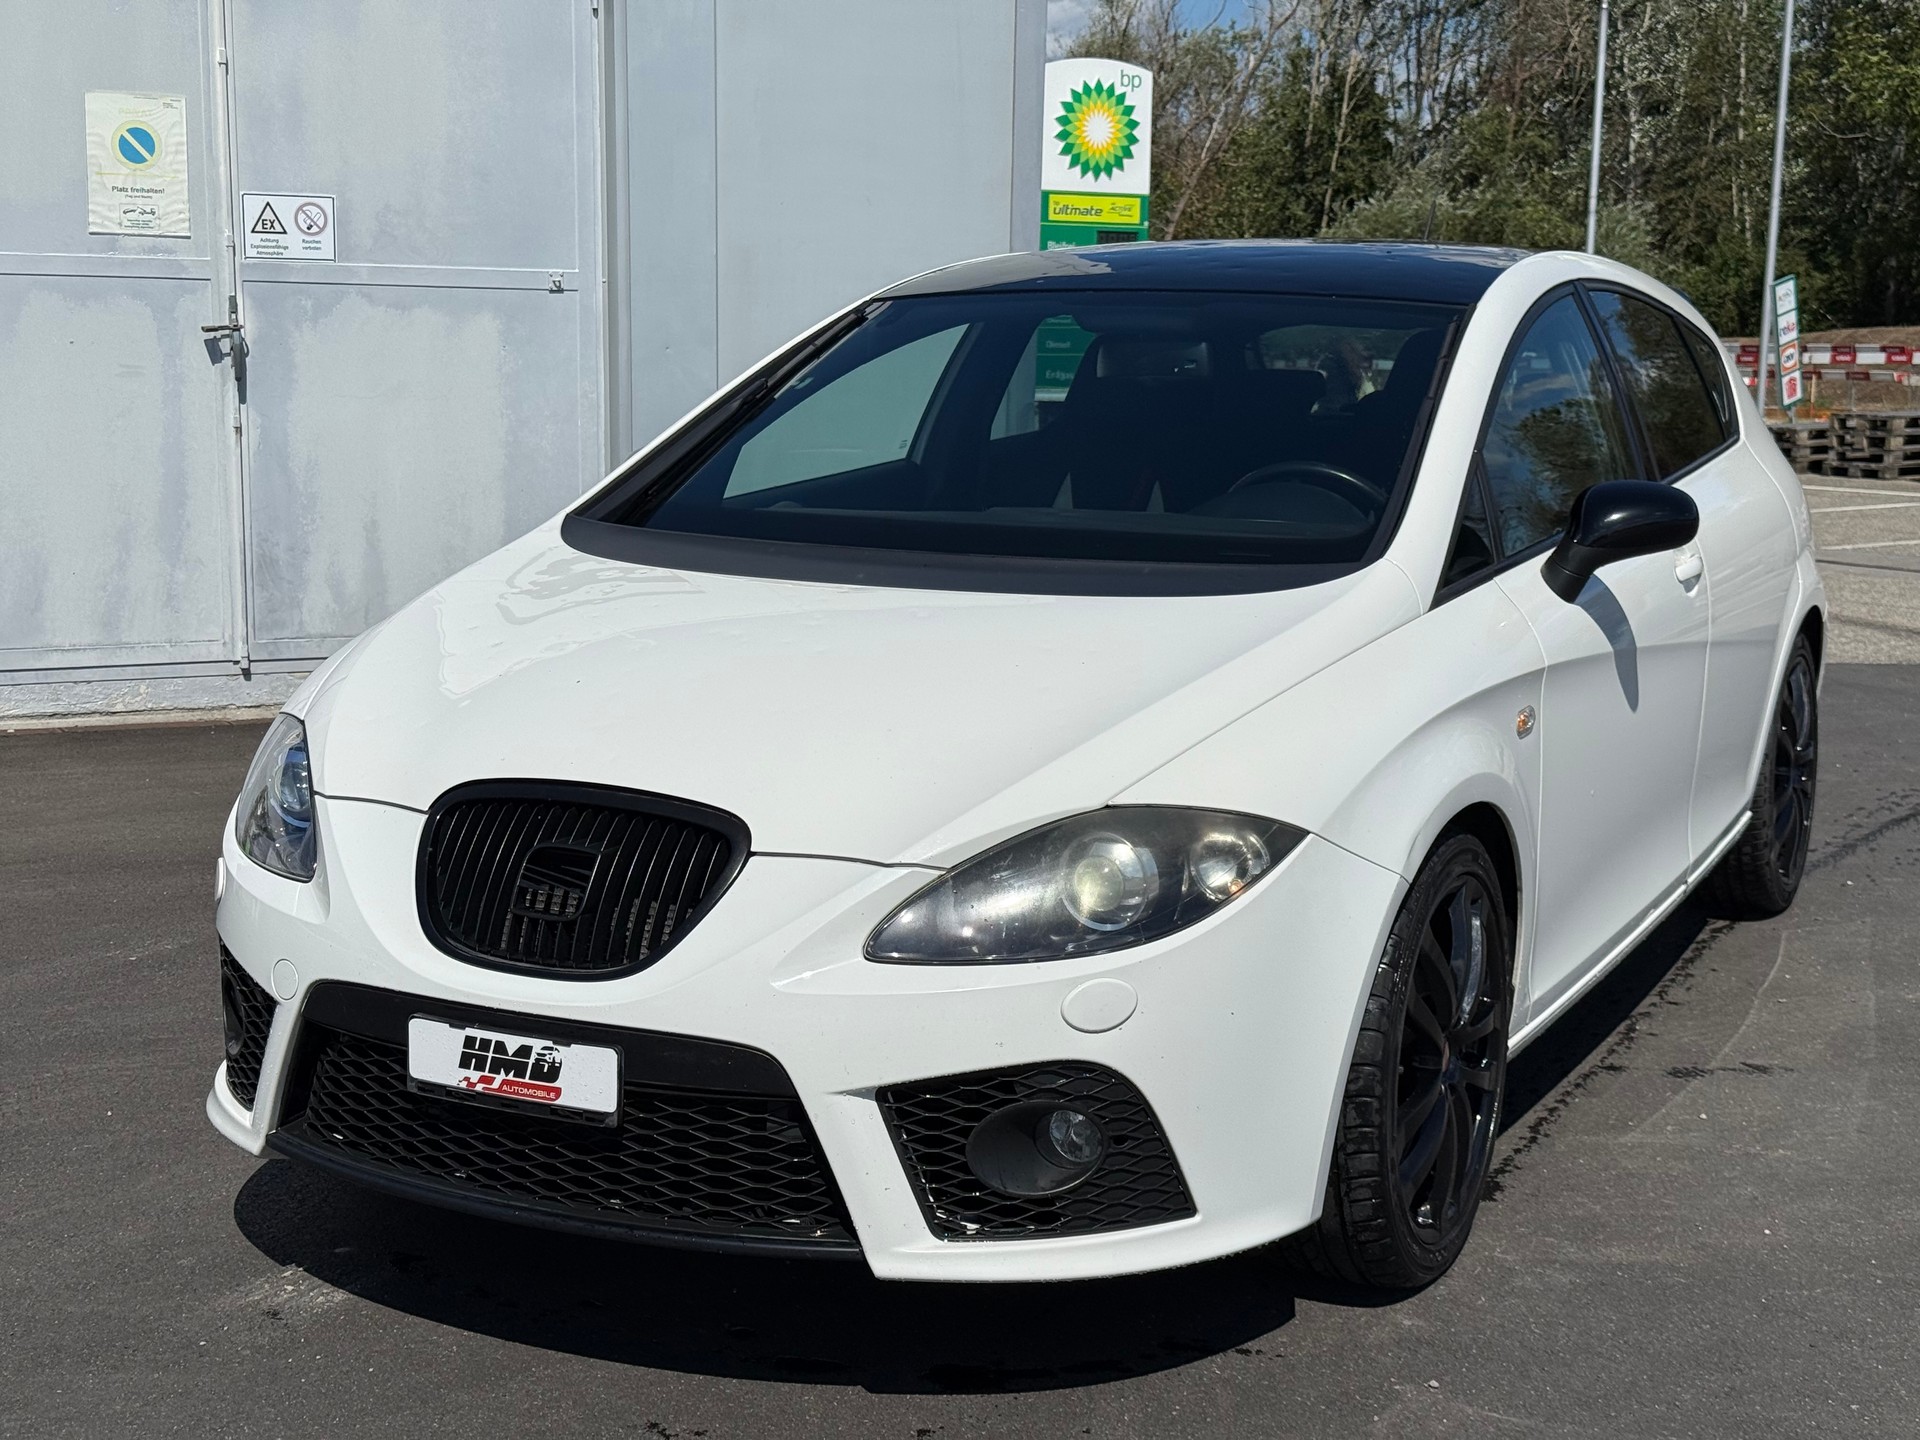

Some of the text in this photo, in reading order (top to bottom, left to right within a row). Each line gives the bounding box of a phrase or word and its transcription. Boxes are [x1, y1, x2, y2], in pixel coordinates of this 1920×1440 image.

[1120, 69, 1142, 92] bp
[130, 187, 165, 195] freihalten!
[1053, 204, 1103, 217] ultimate
[261, 218, 276, 231] EX
[502, 1084, 556, 1099] AUTOMOBILE
